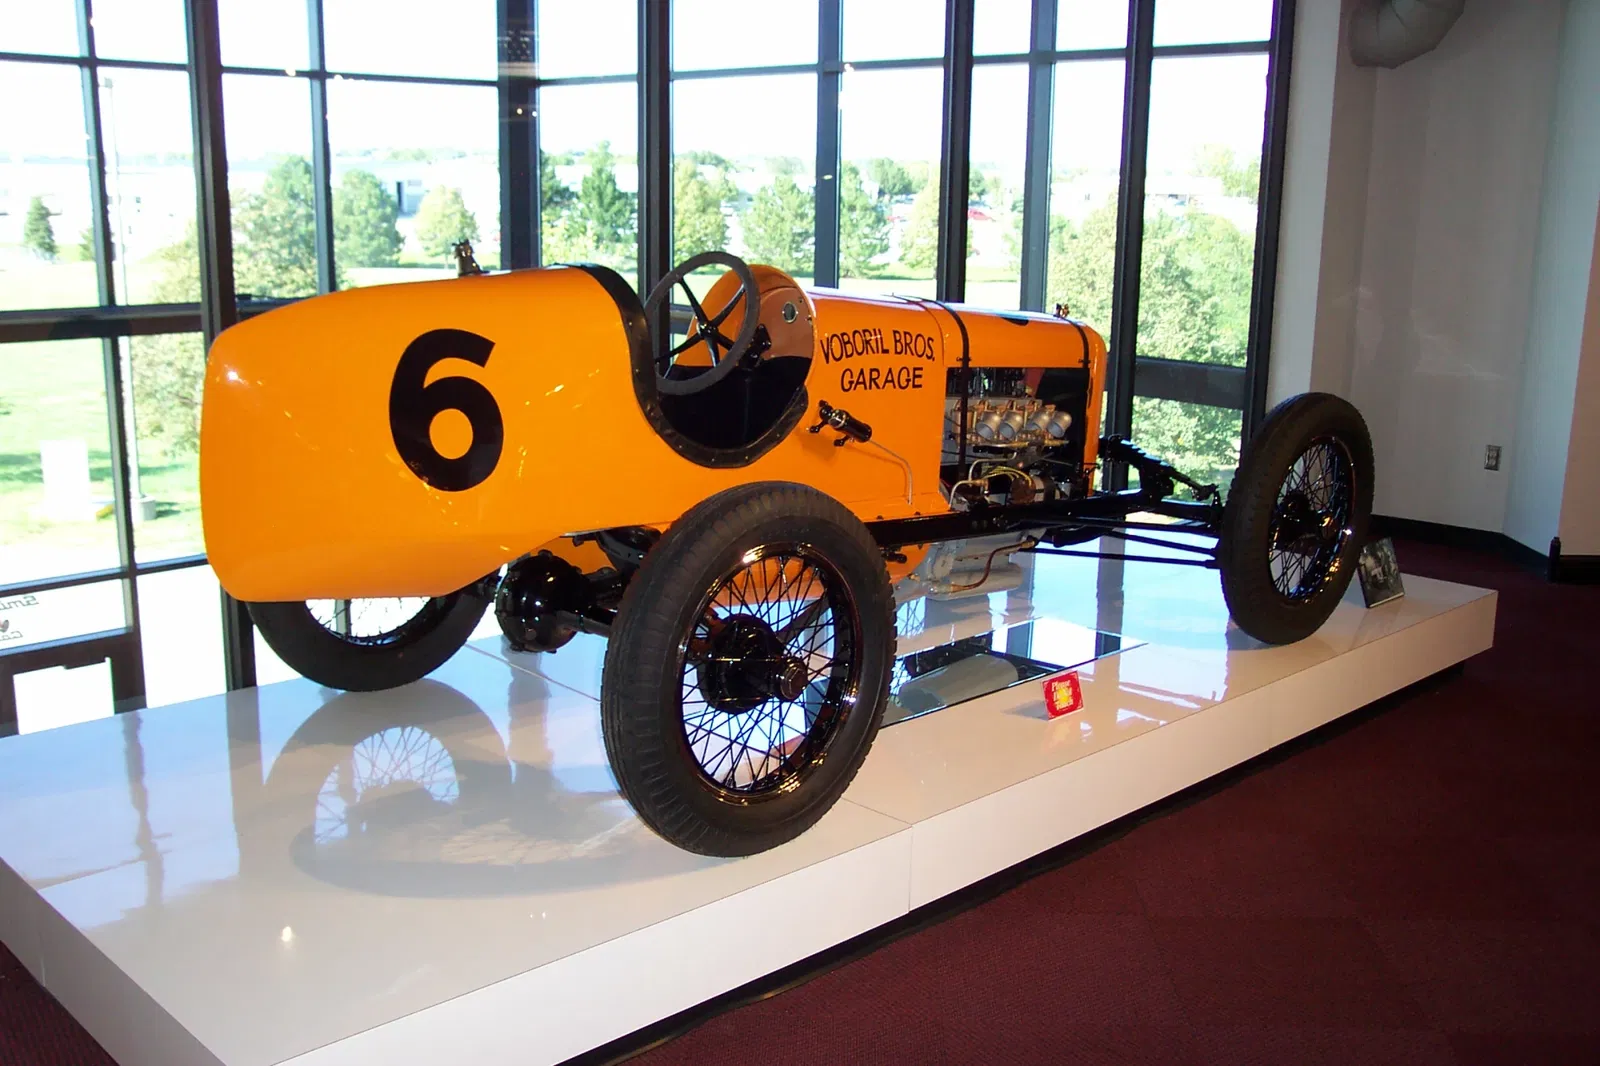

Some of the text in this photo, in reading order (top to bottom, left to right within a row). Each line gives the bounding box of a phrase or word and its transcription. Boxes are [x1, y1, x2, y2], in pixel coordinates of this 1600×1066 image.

[820, 328, 935, 364] VOBORIL BROS.
[840, 366, 923, 392] GARAGE
[389, 328, 504, 492] 6
